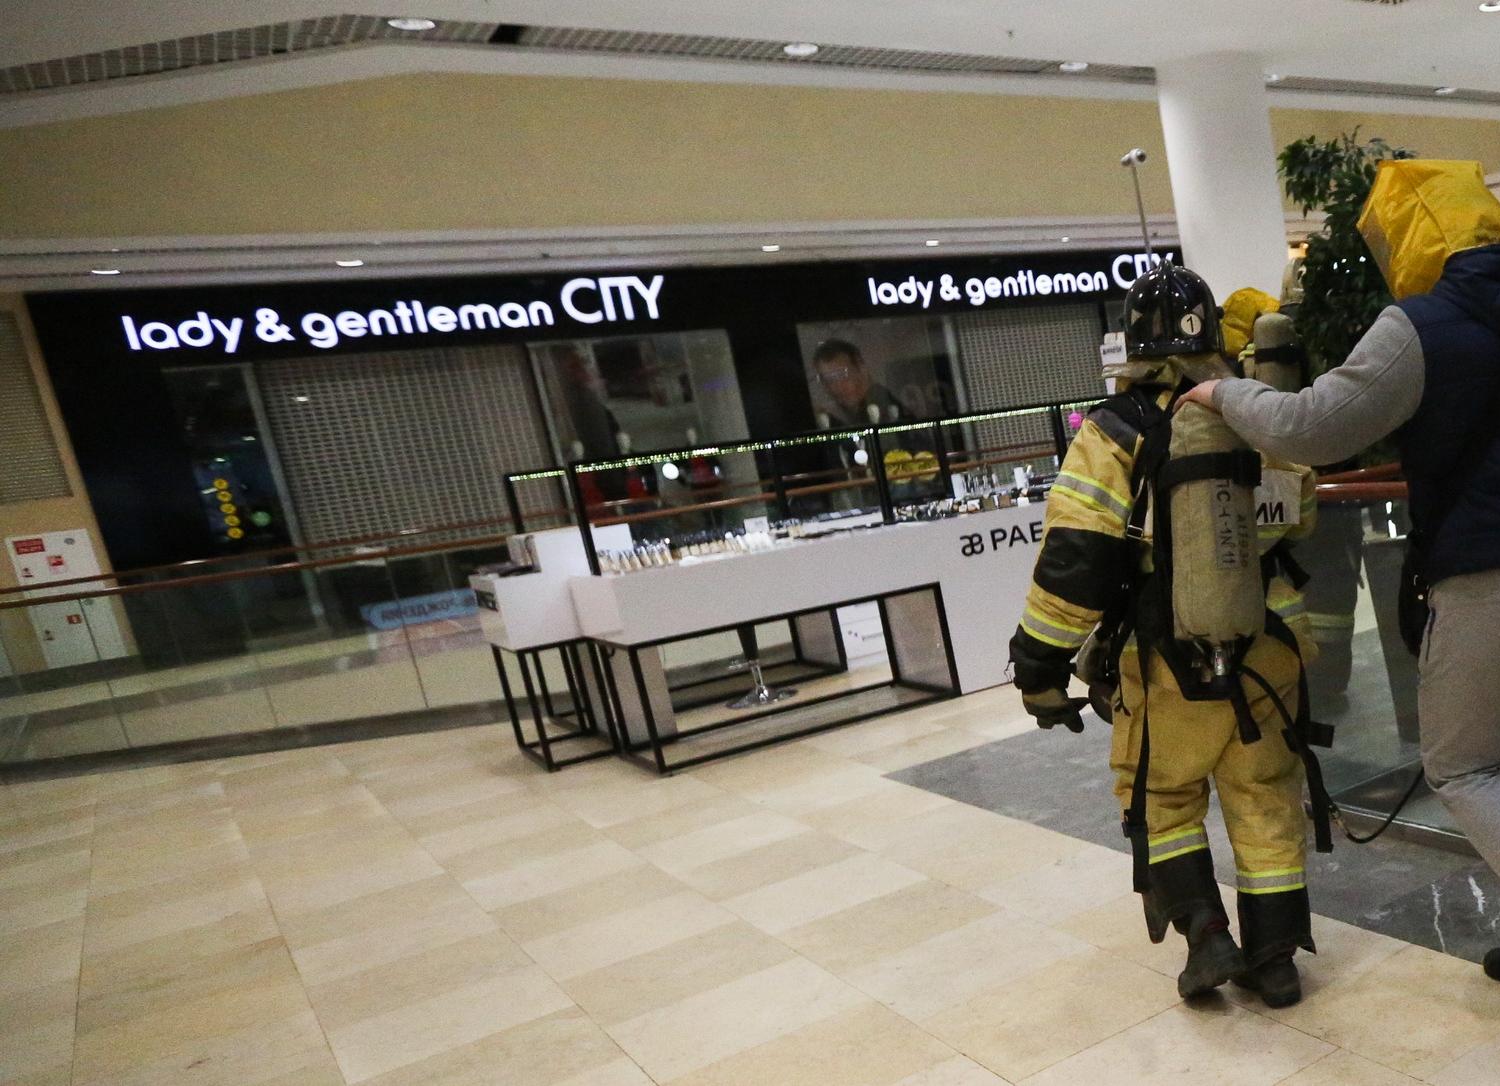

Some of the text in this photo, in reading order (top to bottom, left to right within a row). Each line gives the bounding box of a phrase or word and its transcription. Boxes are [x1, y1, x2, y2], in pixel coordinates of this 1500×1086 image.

[868, 276, 933, 308] lady
[939, 274, 961, 300] &
[965, 270, 1108, 305] gentleman
[121, 275, 664, 353] lady & gentleman CITY
[1187, 316, 1194, 333] 1
[990, 521, 1043, 551] PAE
